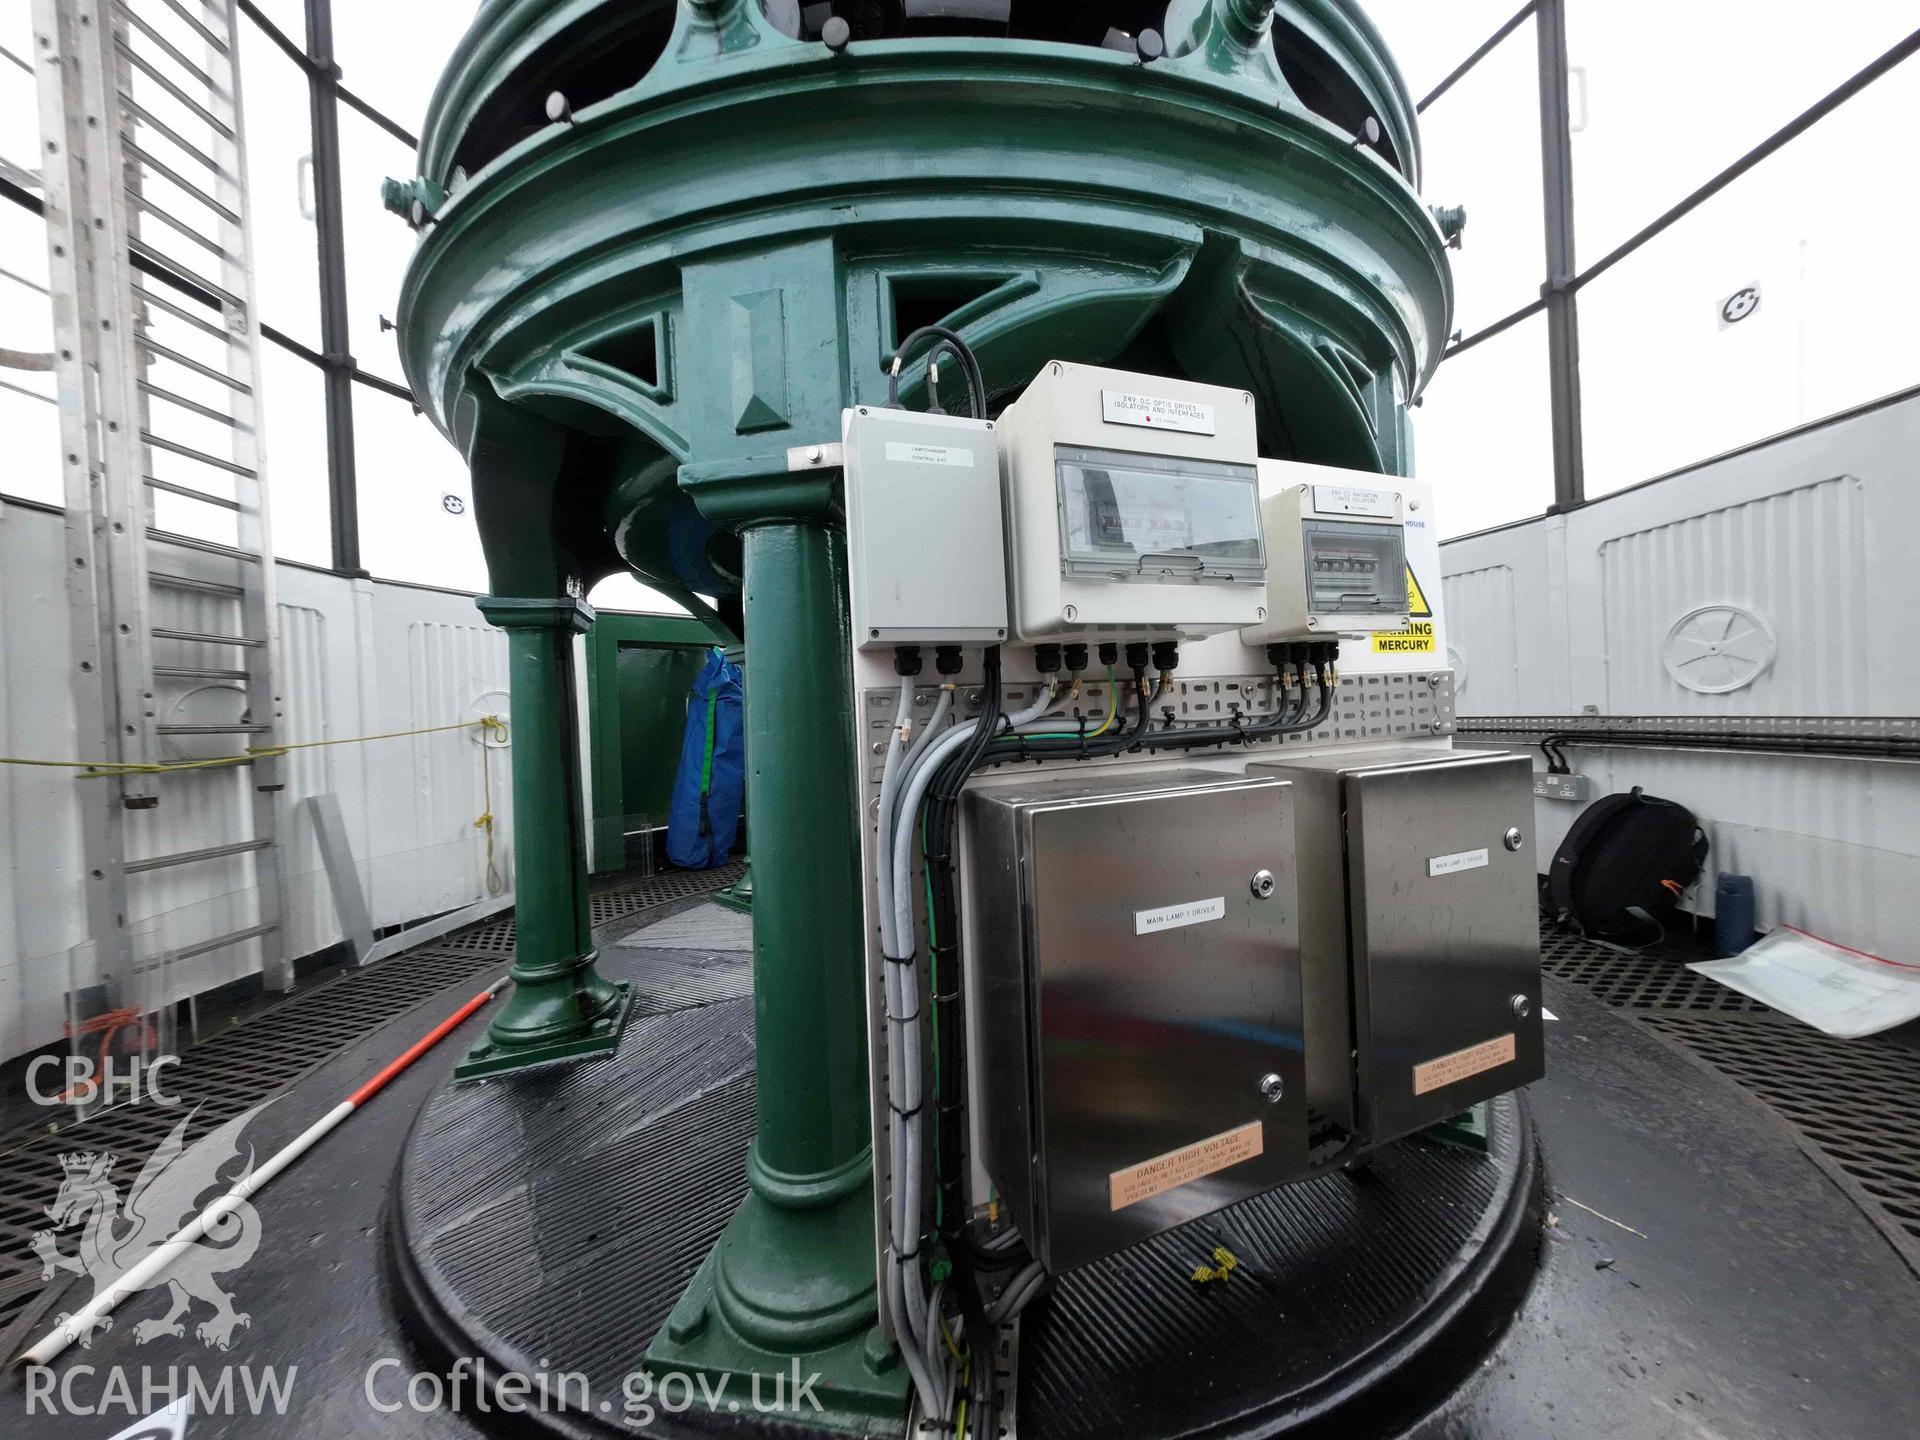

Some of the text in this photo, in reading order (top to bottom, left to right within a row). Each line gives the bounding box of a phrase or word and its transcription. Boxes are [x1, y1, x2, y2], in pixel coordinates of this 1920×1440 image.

[1114, 401, 1149, 412] ISOLATORS
[1168, 408, 1205, 419] INTERFACES
[1153, 400, 1172, 408] OPTIC
[1175, 402, 1196, 411] DRIVES
[1405, 520, 1425, 528] HOUSE
[1379, 640, 1429, 650] MERCURY
[1146, 916, 1163, 925] MAIN
[1167, 912, 1184, 921] LAMP
[1192, 906, 1216, 916] DRIVER
[1136, 1135, 1241, 1179] DANGER HIGH VOLTAGE
